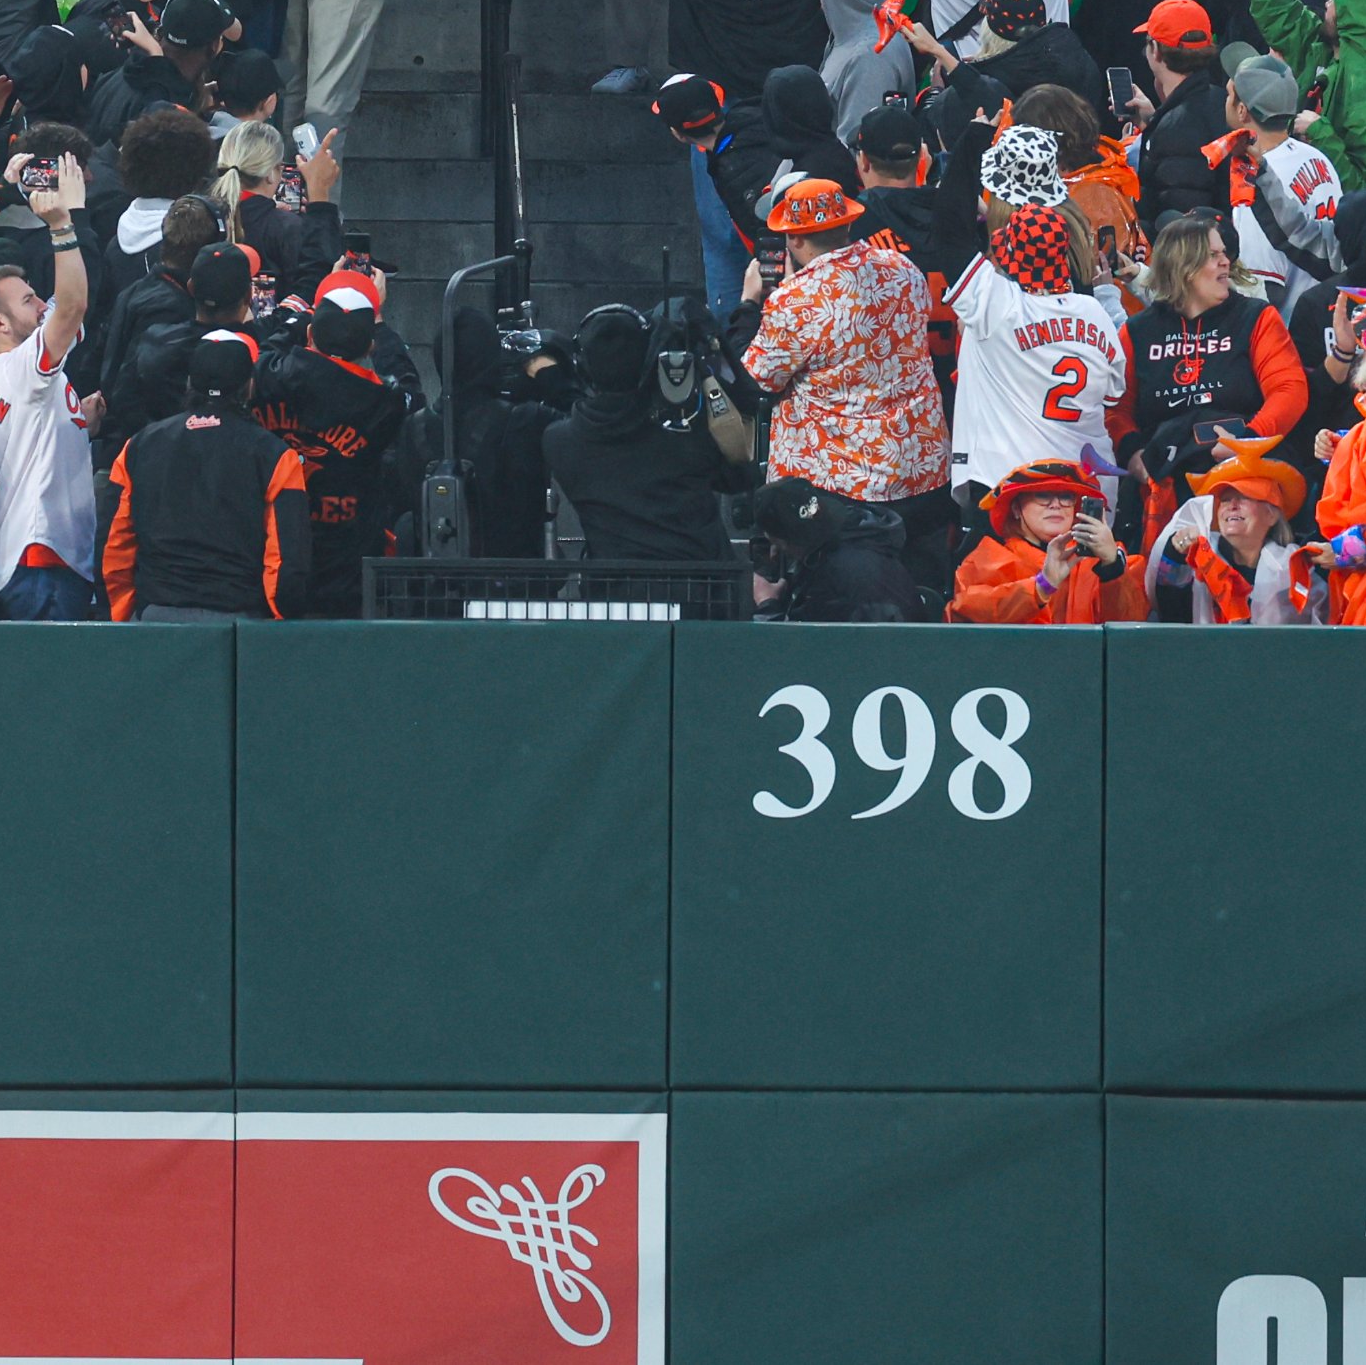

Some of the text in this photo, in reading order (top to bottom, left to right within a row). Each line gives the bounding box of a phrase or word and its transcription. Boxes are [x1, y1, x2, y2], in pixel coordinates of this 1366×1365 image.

[1014, 317, 1118, 366] HENDERSON
[1149, 337, 1233, 361] ORIOLES
[1165, 329, 1219, 343] BALTIMORE
[1041, 355, 1089, 423] 2
[1154, 381, 1224, 398] BASEBALL
[752, 684, 1033, 821] 398
